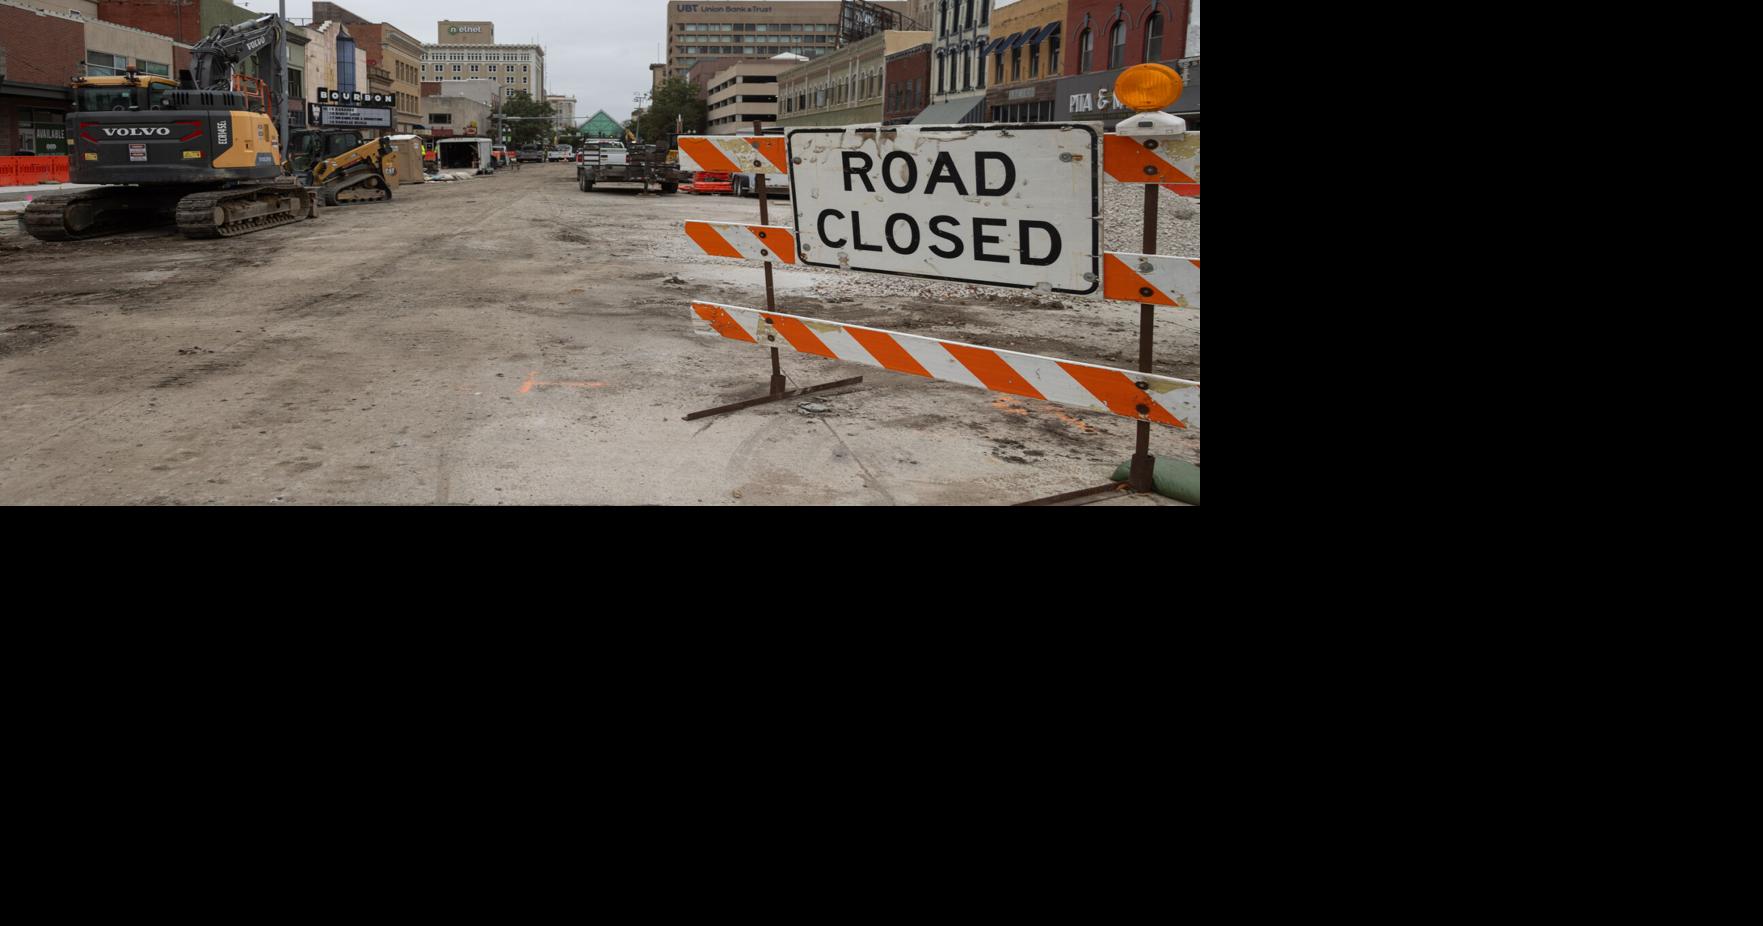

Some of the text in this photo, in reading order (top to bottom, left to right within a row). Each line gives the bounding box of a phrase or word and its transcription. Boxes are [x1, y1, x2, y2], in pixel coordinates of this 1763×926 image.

[677, 4, 698, 13] UBT
[246, 36, 265, 50] VOLVO
[320, 91, 392, 102] BOURBON
[1069, 93, 1093, 113] PITA
[1097, 88, 1110, 110] &
[36, 128, 65, 139] AVAILABLE
[102, 127, 171, 137] VOLVO
[841, 151, 1017, 197] ROAD
[816, 208, 1063, 267] CLOSED
